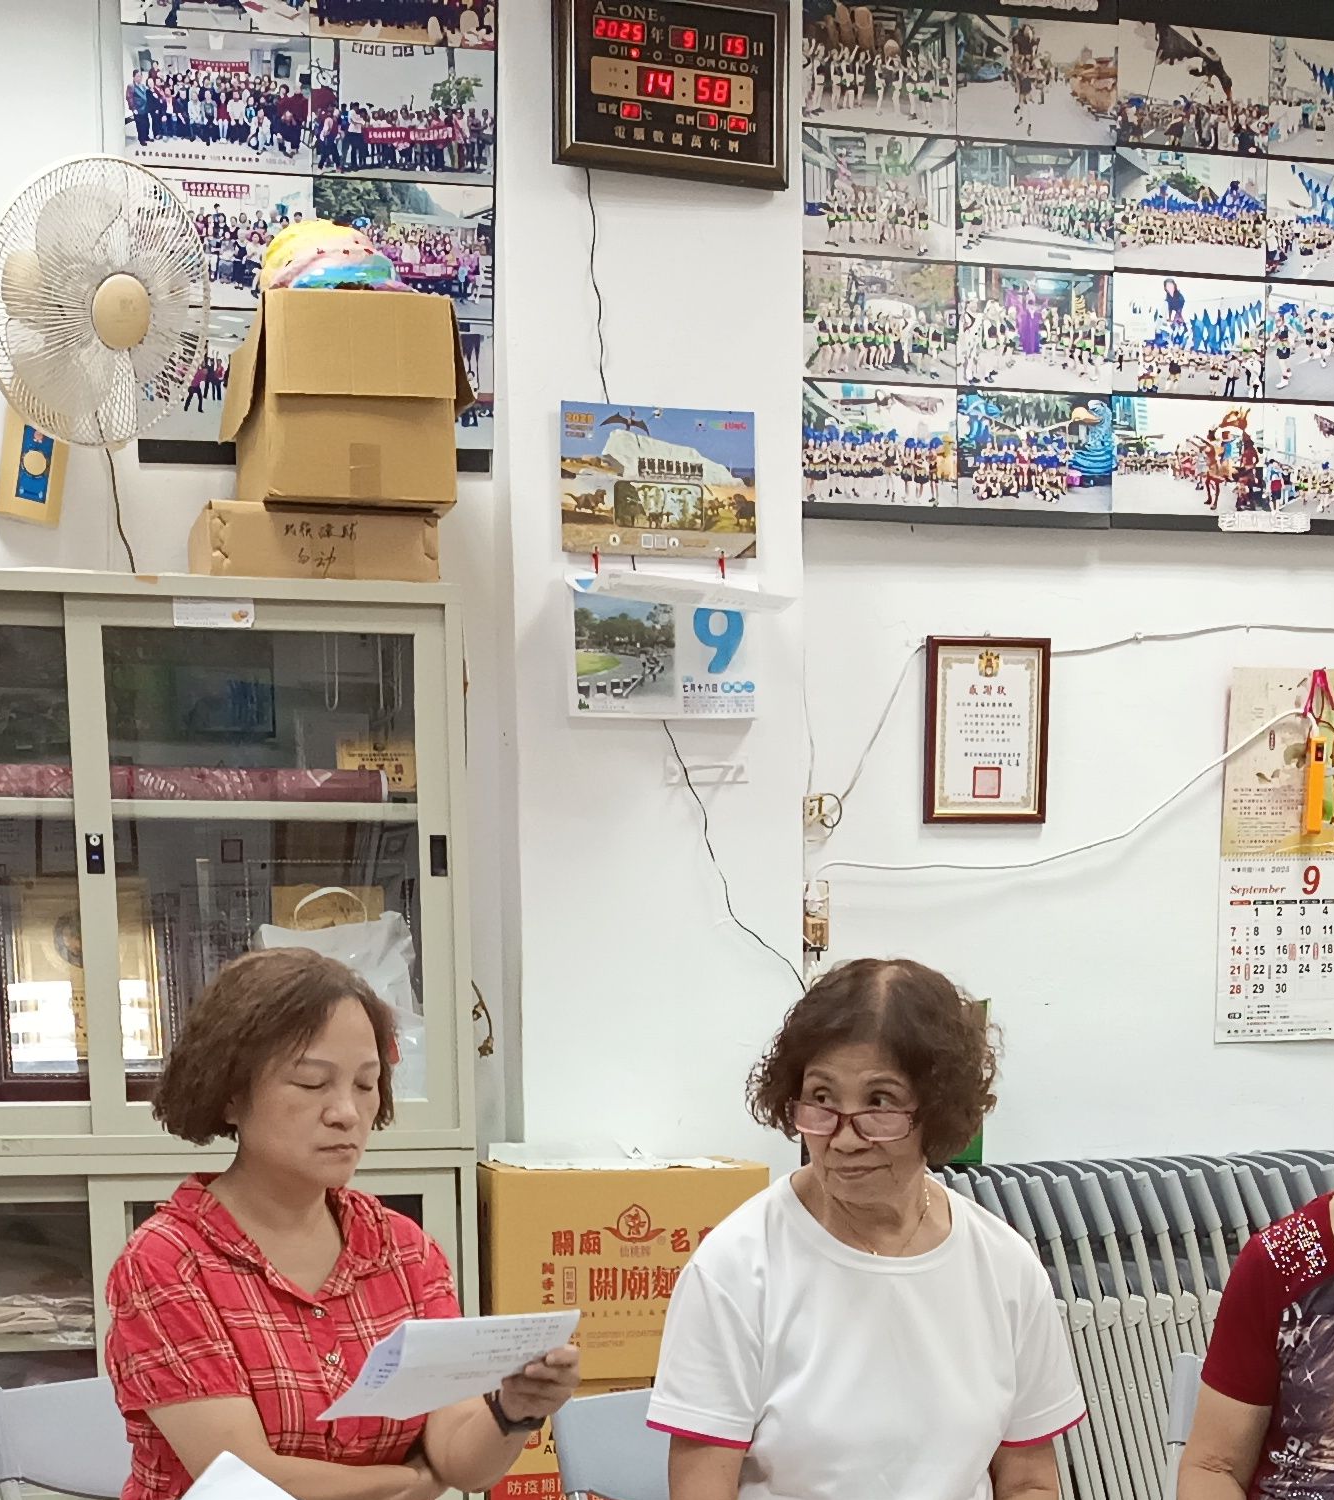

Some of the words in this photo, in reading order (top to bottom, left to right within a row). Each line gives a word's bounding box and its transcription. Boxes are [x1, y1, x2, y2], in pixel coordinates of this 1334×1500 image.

[593, 0, 658, 21] A-ONE
[595, 19, 644, 42] 2025
[683, 30, 695, 48] 9
[726, 38, 744, 55] 15
[648, 72, 672, 95] 14
[697, 78, 729, 103] 58
[693, 608, 744, 674] 9
[1302, 865, 1321, 895] 9
[1229, 885, 1287, 897] September
[1255, 908, 1258, 916] 1
[1277, 907, 1282, 916] 2
[1300, 907, 1305, 915] 3
[1323, 906, 1328, 915] 4
[1231, 927, 1236, 935] 7
[1254, 927, 1259, 935] 8
[1277, 926, 1282, 935] 9
[1300, 926, 1311, 935] 10
[1323, 926, 1333, 934] 11
[1231, 946, 1242, 955] 14
[1254, 946, 1265, 955] 15
[1277, 945, 1287, 954] 16
[1300, 945, 1310, 954] 17
[1322, 945, 1333, 953] 18
[1230, 966, 1240, 975] 21
[1253, 965, 1264, 974] 22
[1276, 965, 1287, 973] 23
[1299, 965, 1310, 973] 24
[1321, 964, 1332, 972] 25
[1230, 985, 1241, 994] 28
[1253, 985, 1264, 993] 29
[1275, 984, 1286, 993] 30
[552, 1229, 602, 1257] 關廟
[589, 1265, 683, 1302] 關廟麵
